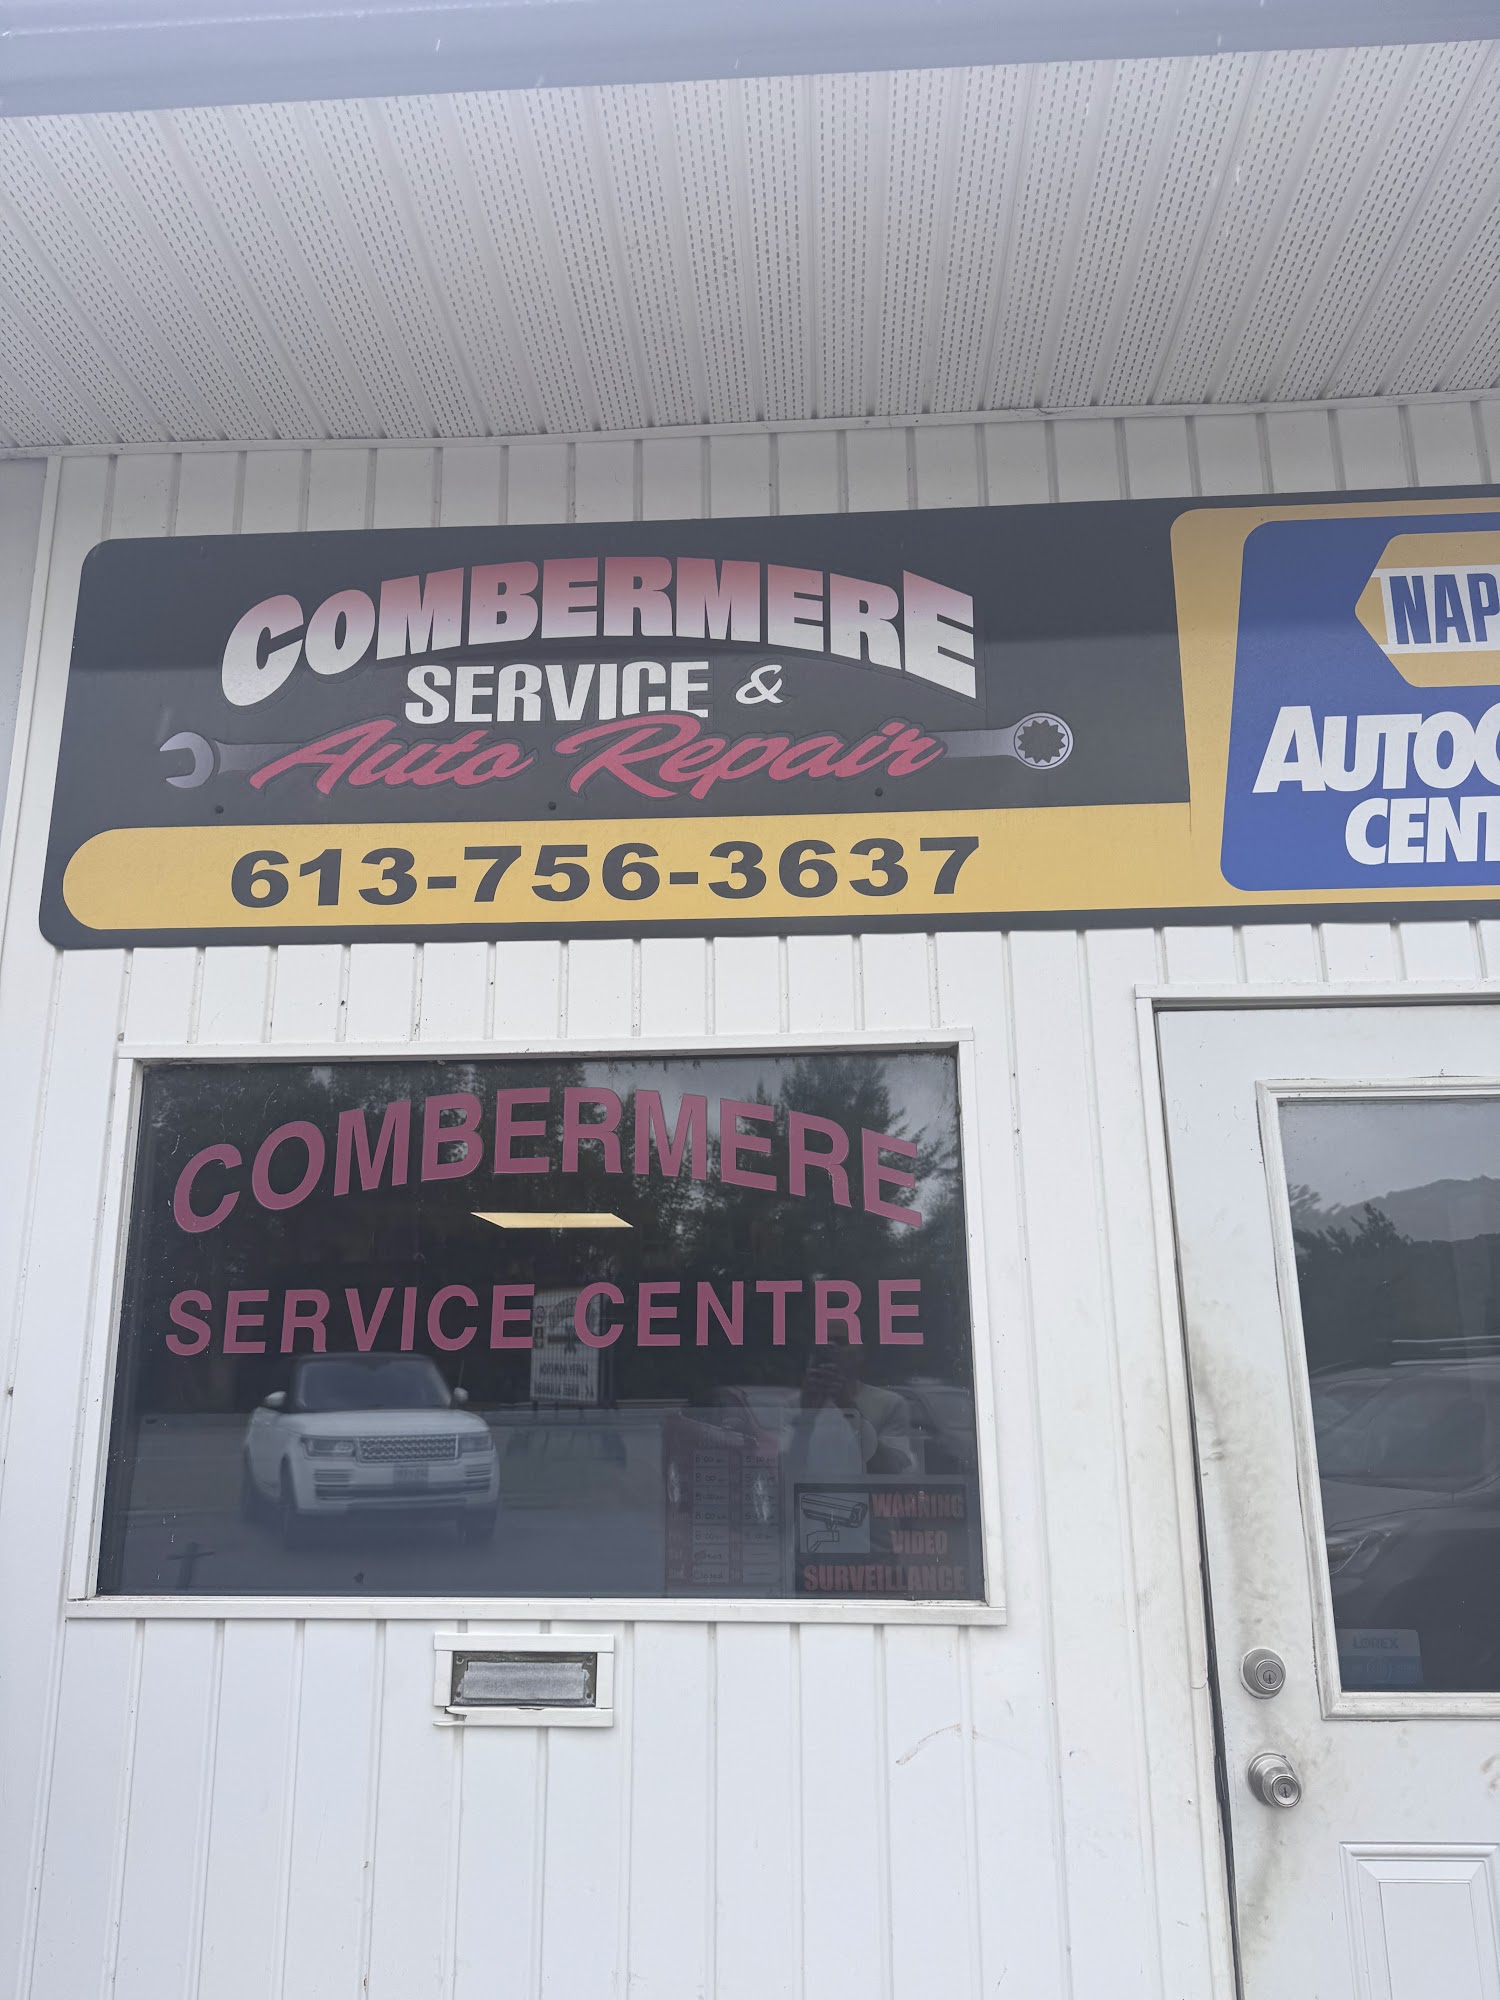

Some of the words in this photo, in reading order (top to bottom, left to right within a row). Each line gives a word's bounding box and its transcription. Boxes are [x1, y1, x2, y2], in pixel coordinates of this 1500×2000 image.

[222, 556, 977, 706] COMBERMERE
[405, 661, 709, 724] SERVICE
[735, 664, 784, 705] &
[249, 719, 535, 795] Auto
[555, 714, 944, 801] Repair
[231, 836, 979, 909] 613-756-3637
[174, 1087, 923, 1234] COMBERMERE
[166, 1283, 535, 1356] SERVICE
[574, 1279, 924, 1349] CENTRE
[871, 1493, 964, 1518] WARNING
[889, 1529, 948, 1555] VIDEO
[803, 1564, 966, 1592] SURVEILLANCE
